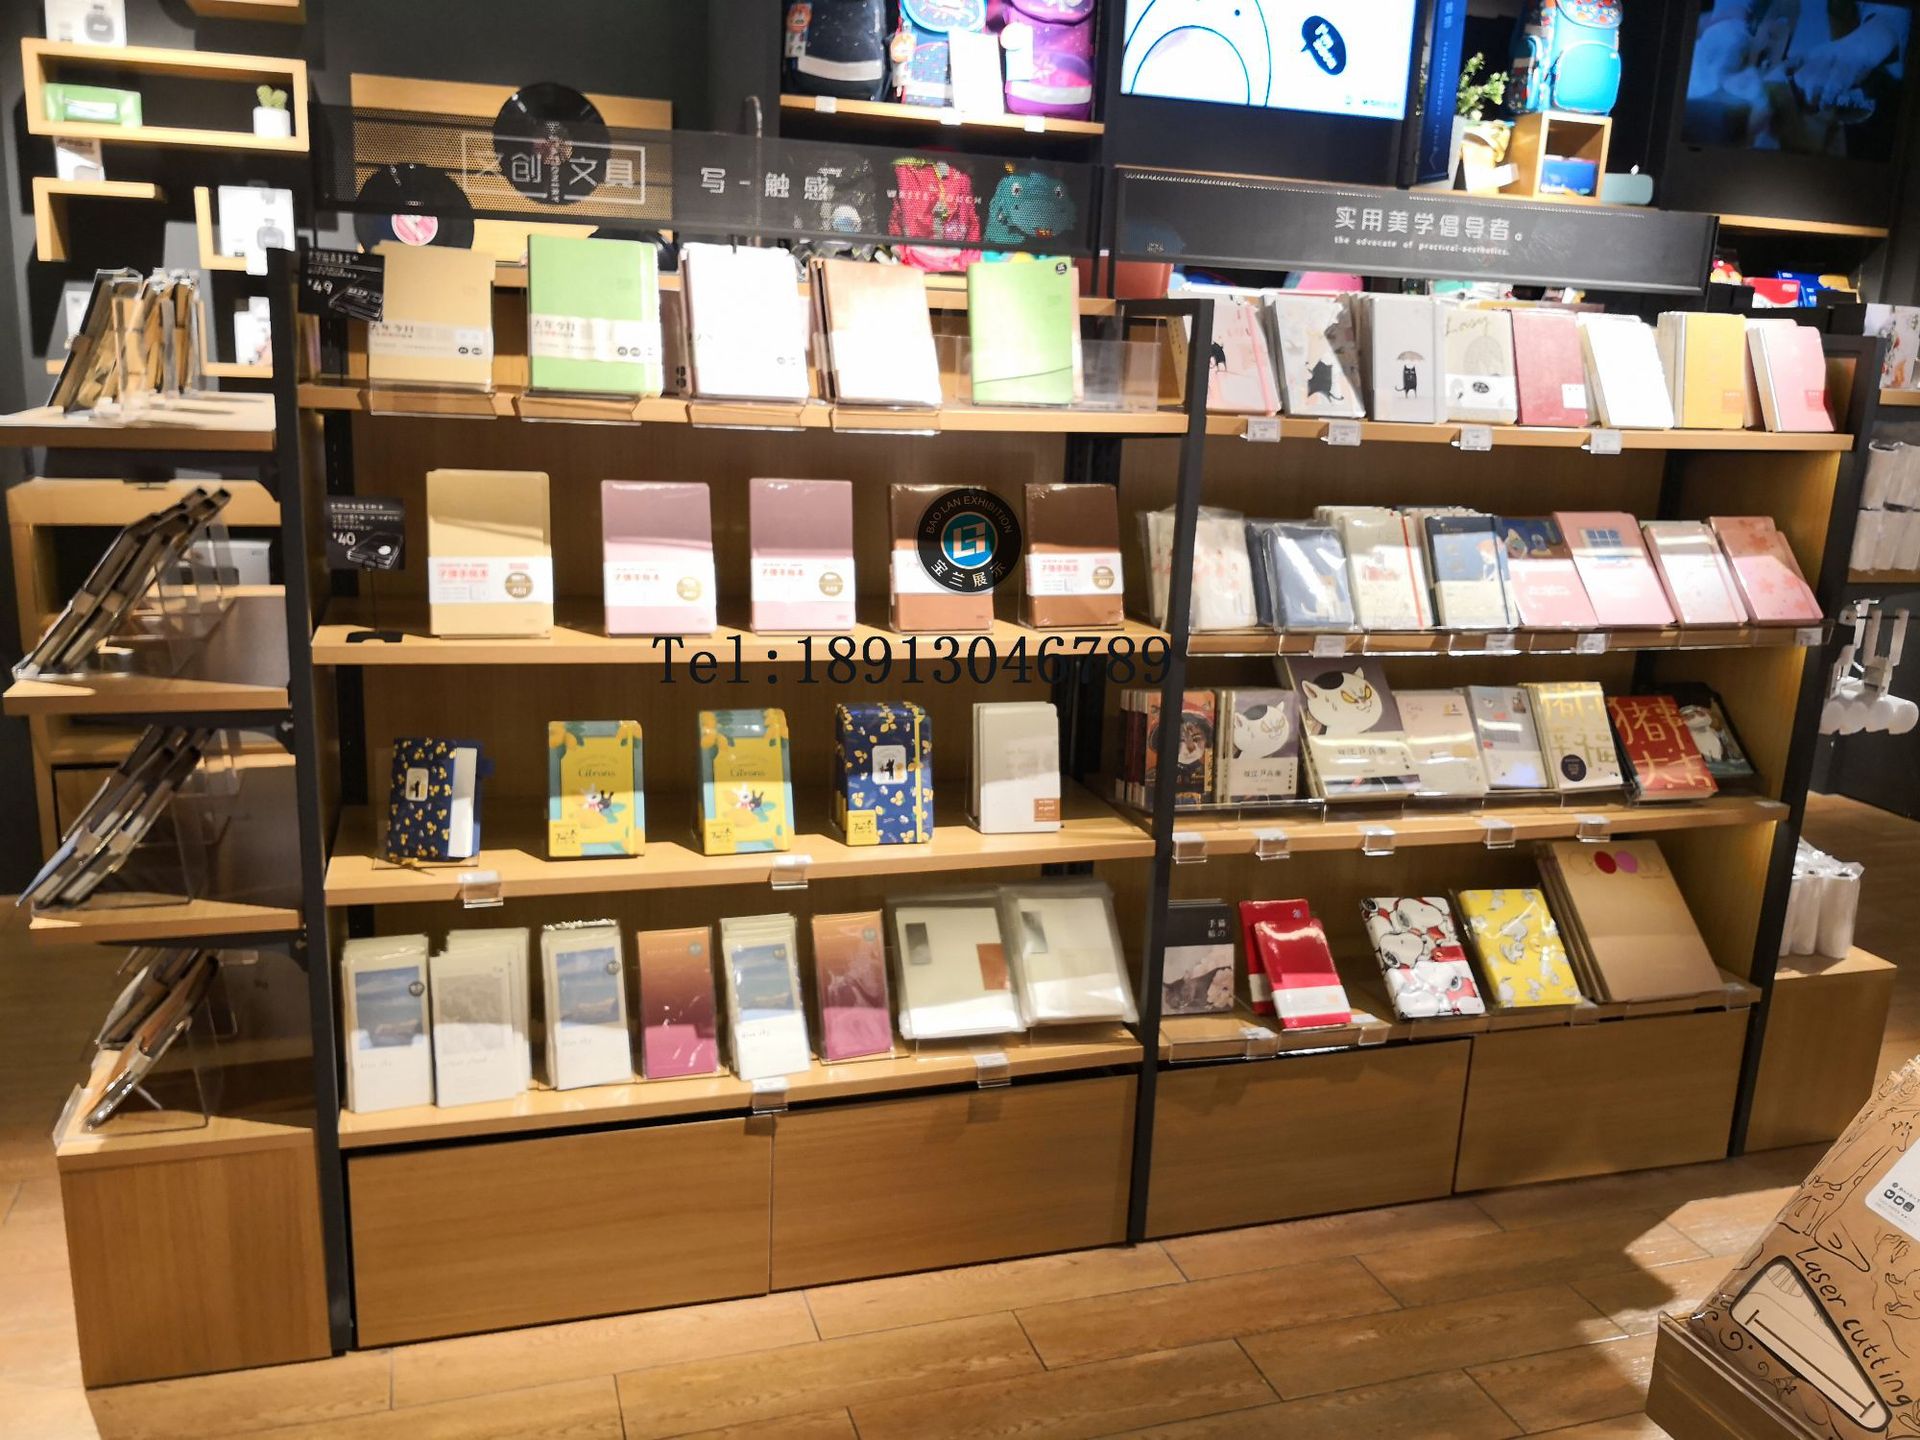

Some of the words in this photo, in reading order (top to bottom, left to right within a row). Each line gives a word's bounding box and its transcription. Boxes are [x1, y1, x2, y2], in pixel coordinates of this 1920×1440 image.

[569, 156, 635, 188] 文具
[937, 193, 982, 204] OUCH
[1334, 235, 1349, 245] the
[1356, 237, 1397, 248] advocate
[1402, 240, 1414, 248] of
[1796, 1246, 1846, 1308] Laser
[1842, 1317, 1912, 1408] cutting
